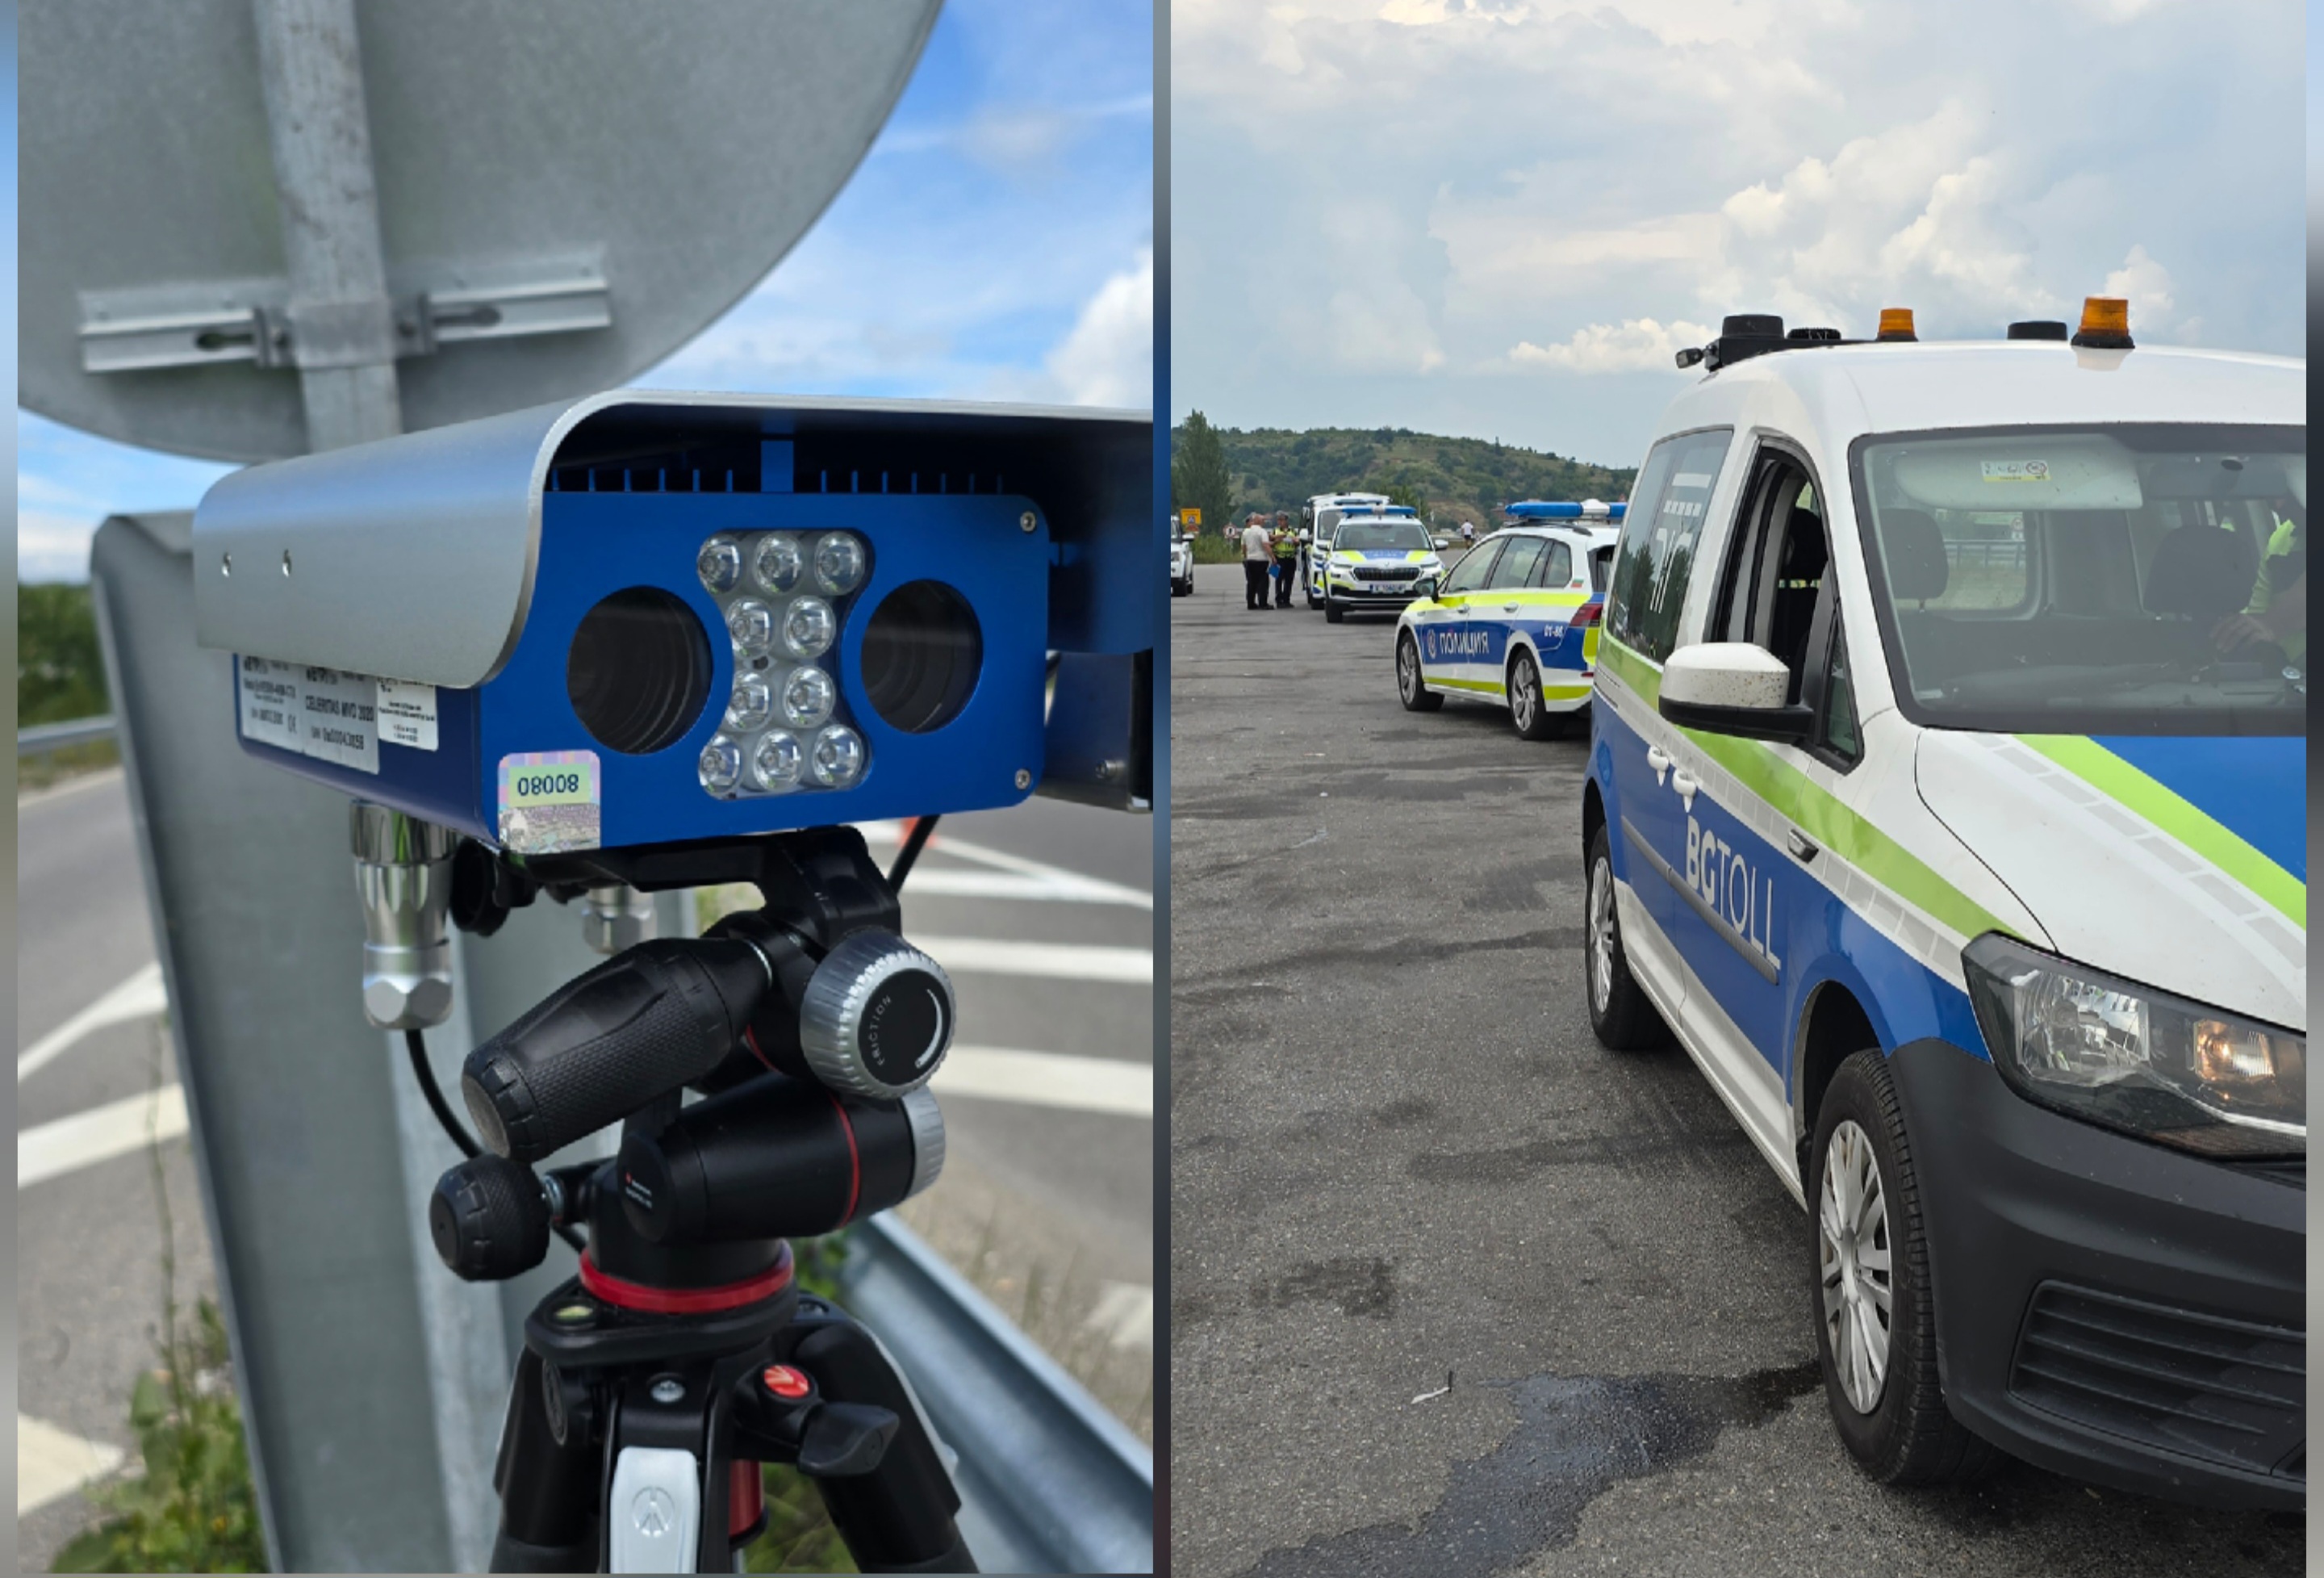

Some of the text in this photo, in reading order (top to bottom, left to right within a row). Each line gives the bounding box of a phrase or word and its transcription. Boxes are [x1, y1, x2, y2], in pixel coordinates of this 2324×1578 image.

[1440, 631, 1490, 657] ПОЛИЦИЯ
[1686, 814, 1781, 970] BGTOLL
[868, 994, 892, 1066] FRICTION
